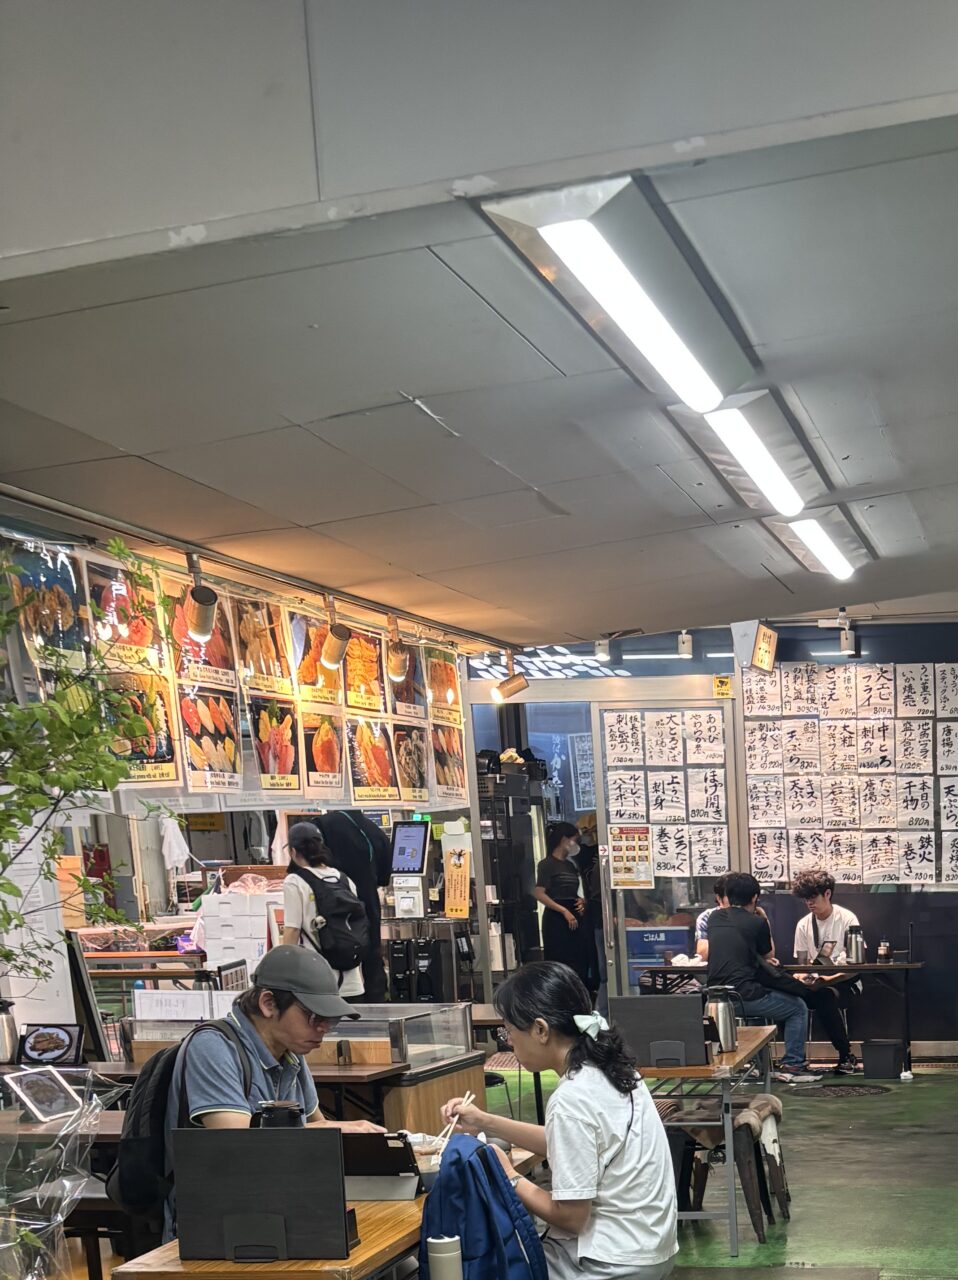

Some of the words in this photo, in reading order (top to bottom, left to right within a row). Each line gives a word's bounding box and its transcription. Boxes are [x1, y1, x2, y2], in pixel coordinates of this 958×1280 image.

[862, 674, 874, 707] フライ
[706, 713, 721, 745] あわび
[861, 724, 875, 755] 刺身
[877, 721, 892, 768] 中とろ
[652, 779, 666, 811] 刺身
[789, 778, 805, 811] 天ぷら
[806, 778, 818, 808] キスの
[902, 780, 919, 811] 干物
[918, 779, 932, 811] 本日の
[655, 826, 672, 856] 巻き
[772, 831, 786, 879] はまぐり
[793, 831, 809, 860] 巻き
[917, 833, 935, 865] 鉄火
[902, 841, 917, 878] 巻き
